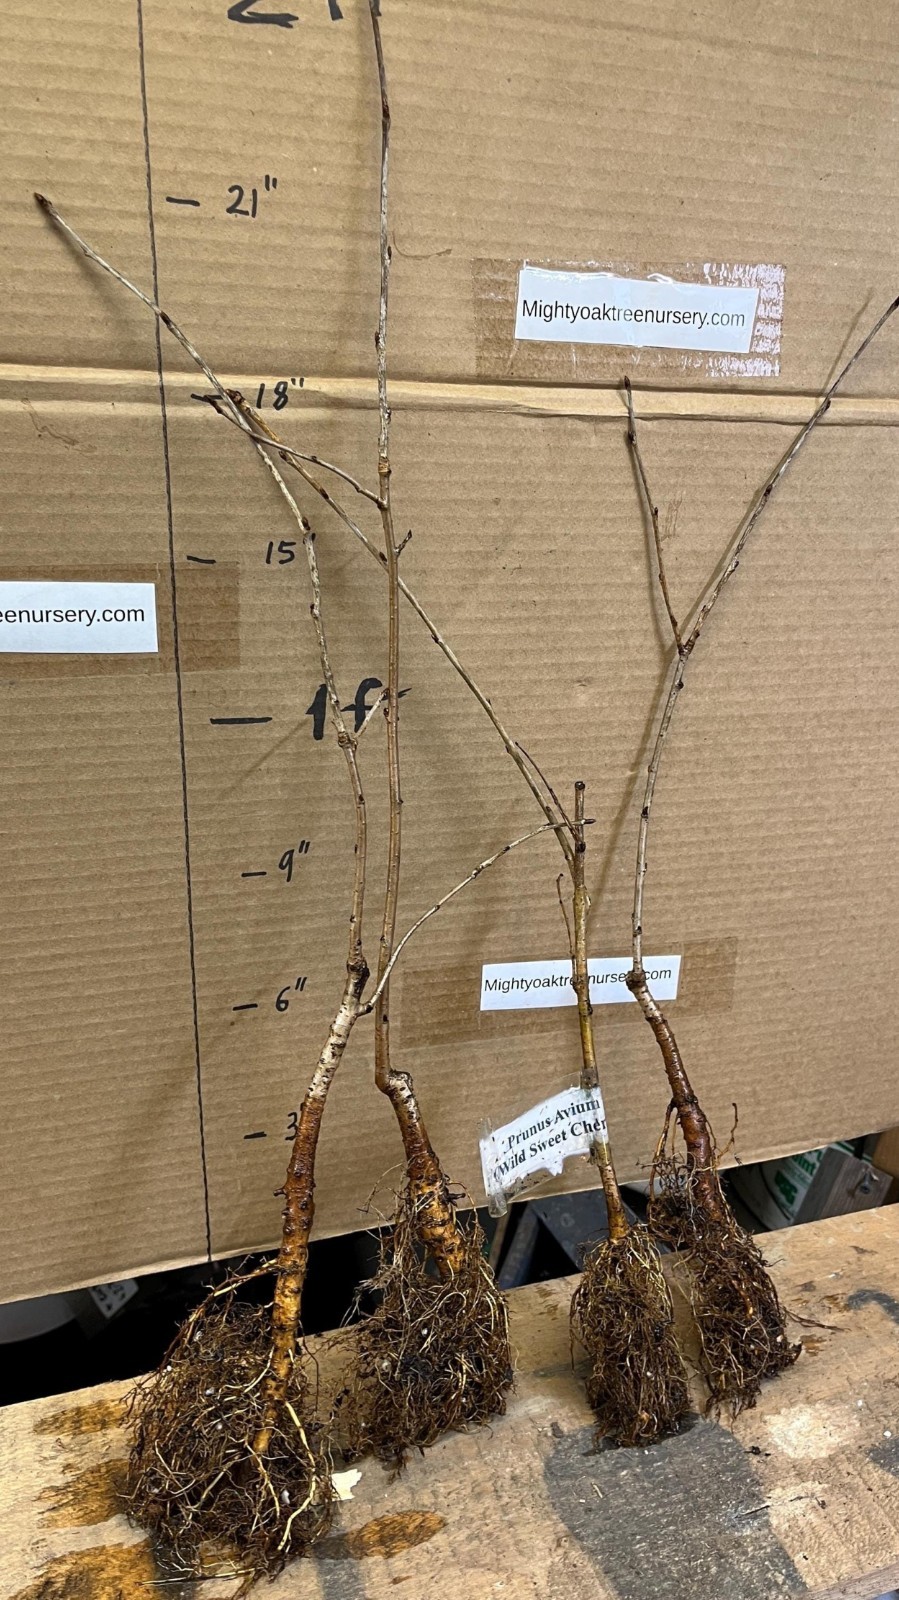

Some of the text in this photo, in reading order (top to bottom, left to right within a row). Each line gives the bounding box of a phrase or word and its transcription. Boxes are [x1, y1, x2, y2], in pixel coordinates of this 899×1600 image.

[226, 174, 278, 218] 21"
[521, 299, 746, 330] Mightyoaktreenursery.com
[255, 377, 305, 410] 18"
[0, 608, 145, 627] enursery.com
[278, 839, 311, 883] 9"
[275, 976, 307, 1012] 6"
[529, 1129, 568, 1158] Sweet
